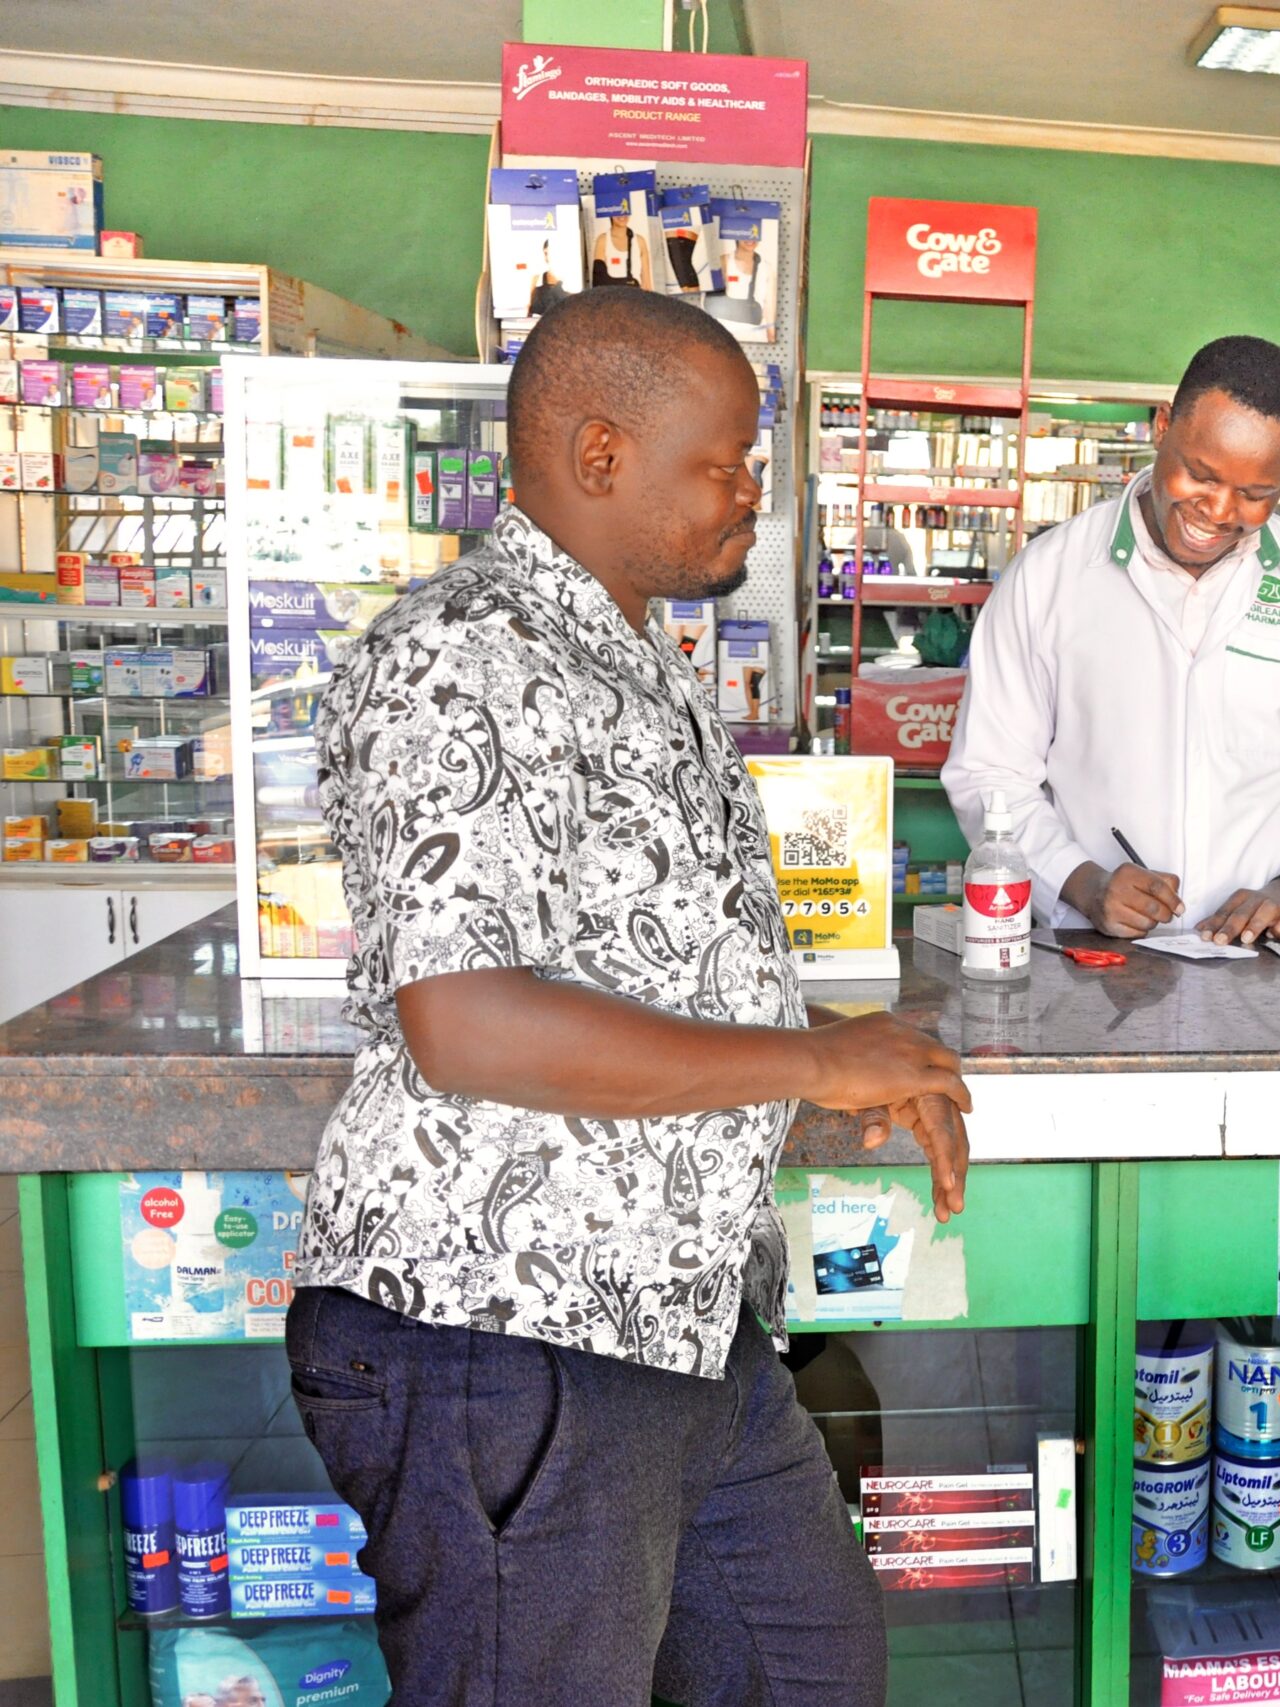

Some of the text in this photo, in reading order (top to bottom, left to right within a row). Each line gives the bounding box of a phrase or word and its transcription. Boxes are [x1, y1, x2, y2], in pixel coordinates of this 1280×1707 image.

[585, 77, 730, 93] ORTHOPAEDIC SOFT GOODS,
[549, 91, 766, 110] BANDAGES, MOBILITY AIDS & HEALTHCARE
[613, 110, 701, 122] PRODUCT RANGE
[918, 251, 990, 278] Gate
[793, 877, 808, 886] the
[811, 877, 839, 886] MoMo
[842, 879, 860, 889] app
[794, 887, 810, 896] dial
[987, 923, 1021, 931] SANITIZER
[145, 1197, 178, 1207] alcohol
[841, 1200, 876, 1214] here
[150, 1209, 174, 1219] Free
[224, 1215, 246, 1224] Easy-
[218, 1230, 255, 1239] applicator
[177, 1266, 216, 1276] DALMAN
[1250, 1402, 1267, 1432] 1
[1162, 1425, 1172, 1441] 1
[1216, 1465, 1272, 1489] Liptomil
[866, 1480, 934, 1491] NEUROCARE
[239, 1508, 309, 1529] DEEP FREEZE
[869, 1518, 936, 1529] NEUROCARE
[1172, 1534, 1186, 1553] 3
[1251, 1531, 1269, 1546] LF
[241, 1546, 311, 1566] DEEP FREEZE
[245, 1582, 315, 1602] DEEP FREEZE
[304, 1666, 346, 1684] Dignity
[1164, 1656, 1250, 1679] MAAMA'S
[296, 1682, 360, 1707] premium
[1209, 1691, 1231, 1702] Safe
[1232, 1688, 1271, 1701] Delivery
[1273, 1686, 1280, 1696] &
